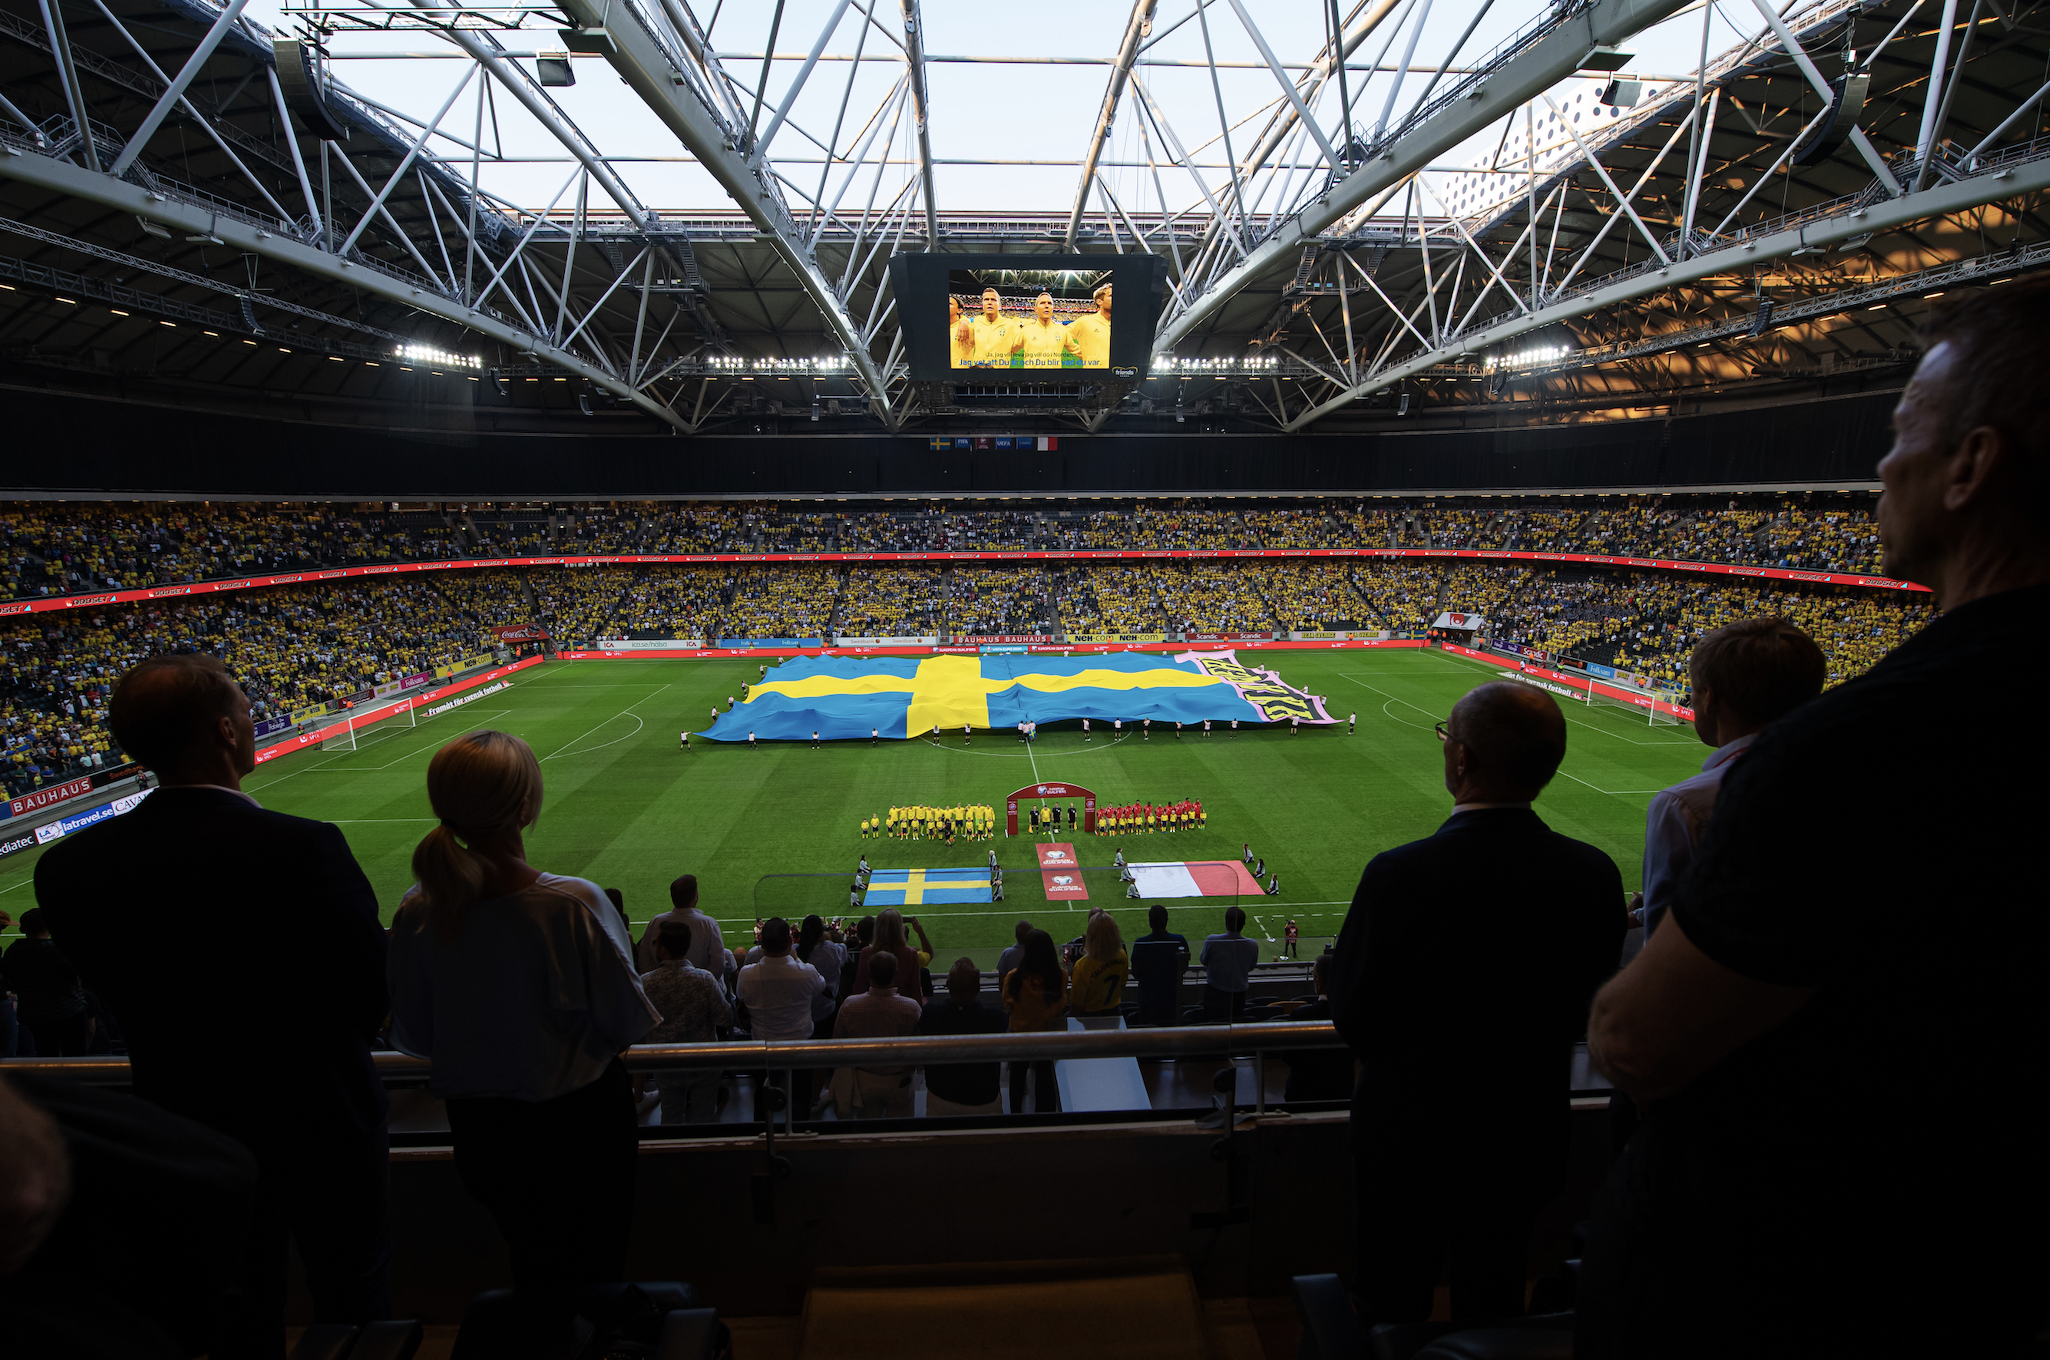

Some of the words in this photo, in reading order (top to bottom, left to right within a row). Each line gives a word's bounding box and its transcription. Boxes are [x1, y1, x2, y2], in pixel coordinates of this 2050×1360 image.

[959, 359, 972, 367] Jag
[1866, 579, 1901, 588] ODDSET
[0, 604, 23, 615] SET
[1005, 635, 1047, 643] BAUHAUS
[1590, 664, 1611, 677] Folksam
[405, 676, 424, 688] Folksam
[464, 689, 484, 703] svensk
[1548, 683, 1572, 696] fotboll
[13, 780, 91, 813] BAUHAUS
[115, 793, 147, 812] CAVA
[62, 807, 114, 832] latravel.se
[0, 836, 34, 856] diatec
[1103, 974, 1120, 1006] 7
